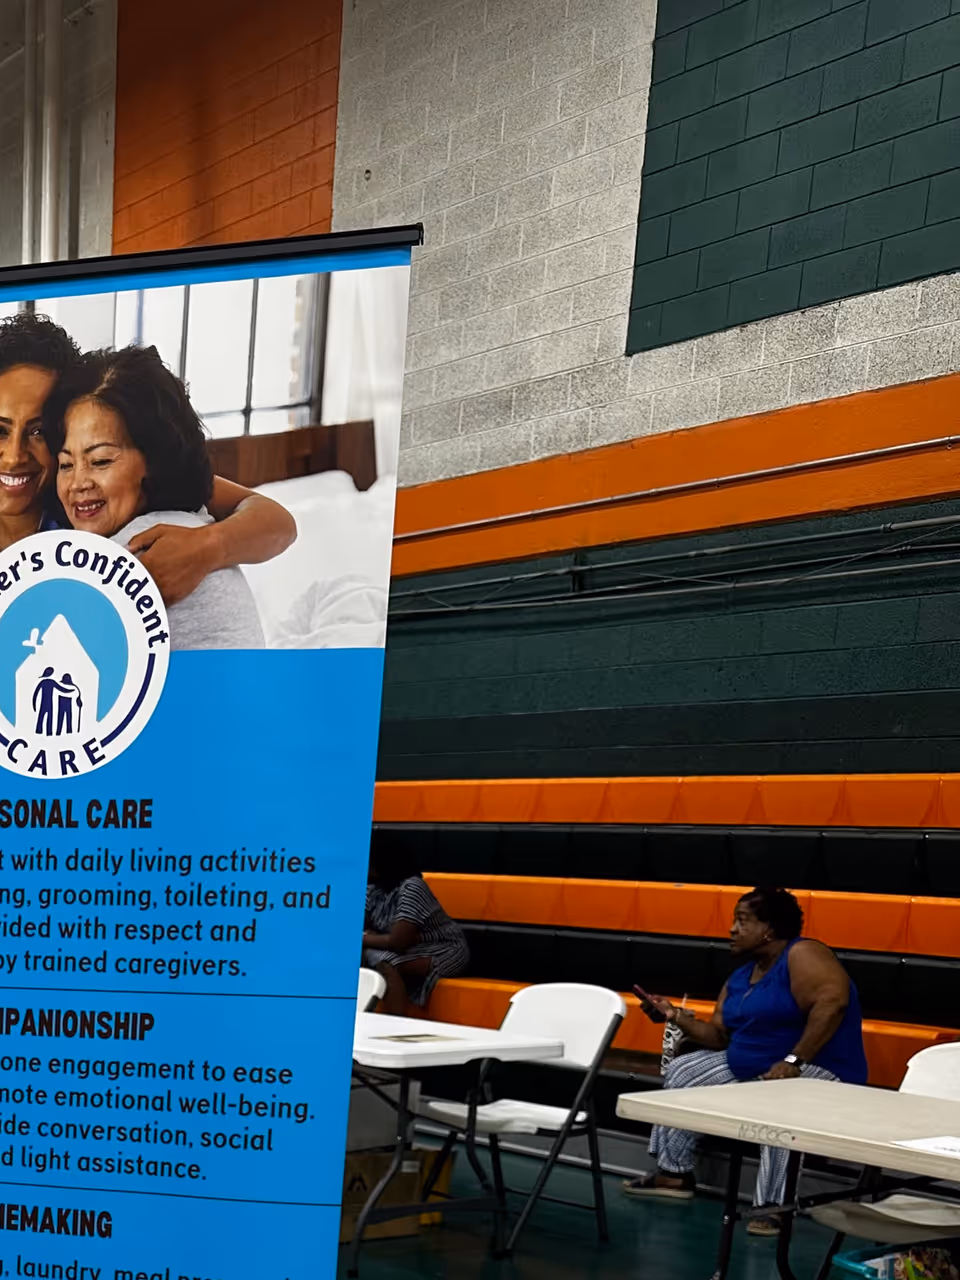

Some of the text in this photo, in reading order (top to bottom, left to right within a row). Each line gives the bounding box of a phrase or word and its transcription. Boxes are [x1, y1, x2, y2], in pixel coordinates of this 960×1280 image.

[55, 541, 169, 648] Confident
[7, 737, 106, 776] CARE
[86, 799, 153, 829] CARE
[11, 847, 57, 871] with
[65, 848, 123, 876] daily
[131, 847, 192, 876] living
[200, 847, 315, 873] activities
[39, 882, 157, 911] grooming,
[165, 882, 274, 912] toileting,
[283, 885, 330, 908] and
[59, 915, 107, 940] with
[115, 920, 202, 944] respect
[210, 918, 256, 942] and
[24, 948, 107, 973] trained
[115, 951, 246, 979] caregivers.
[48, 1058, 195, 1081] engagement
[202, 1061, 225, 1081] to
[233, 1067, 293, 1084] ease
[54, 1086, 172, 1112] emotional
[179, 1092, 314, 1123] well-being.
[37, 1121, 193, 1148] conversation,
[201, 1127, 273, 1151] social
[22, 1146, 70, 1173] light
[77, 1152, 206, 1180] assistance.
